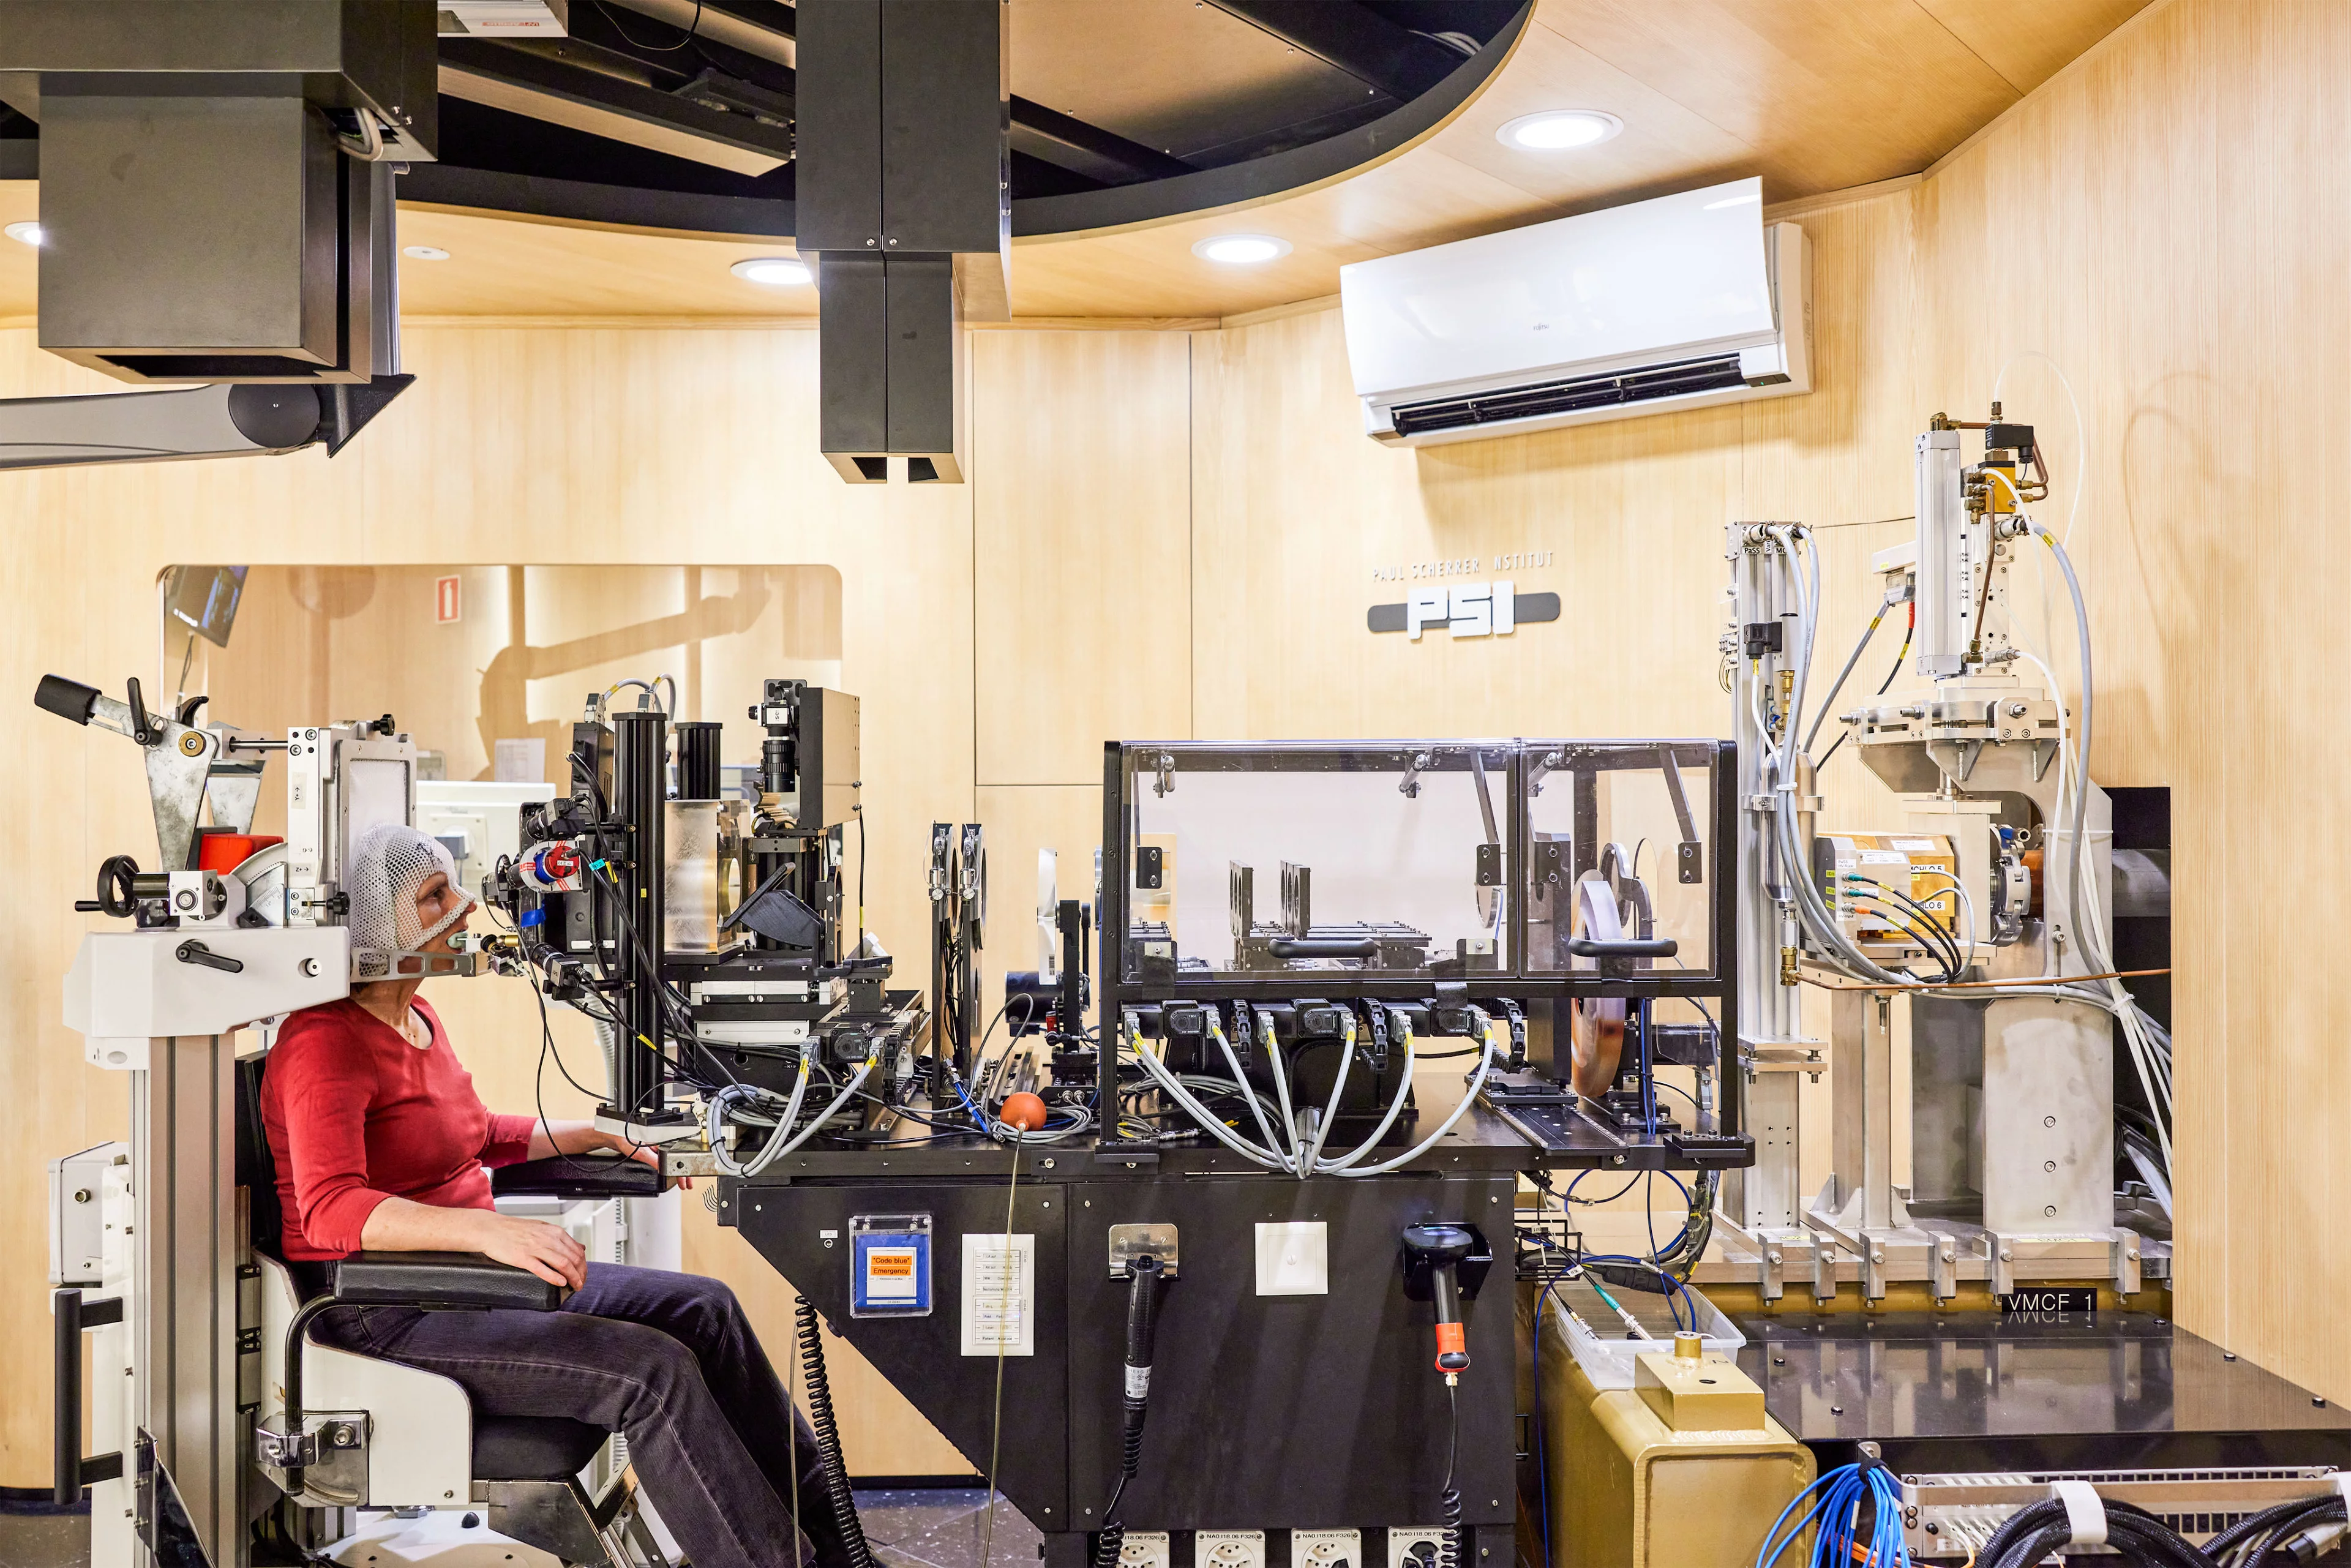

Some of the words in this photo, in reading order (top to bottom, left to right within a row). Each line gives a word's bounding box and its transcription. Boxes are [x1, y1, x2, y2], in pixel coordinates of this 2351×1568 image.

[1373, 566, 1404, 582] PAUL
[1412, 558, 1480, 579] SCHERRER
[1408, 580, 1515, 639] PSI
[2009, 1294, 2070, 1310] VMCF
[2085, 1294, 2091, 1310] 1
